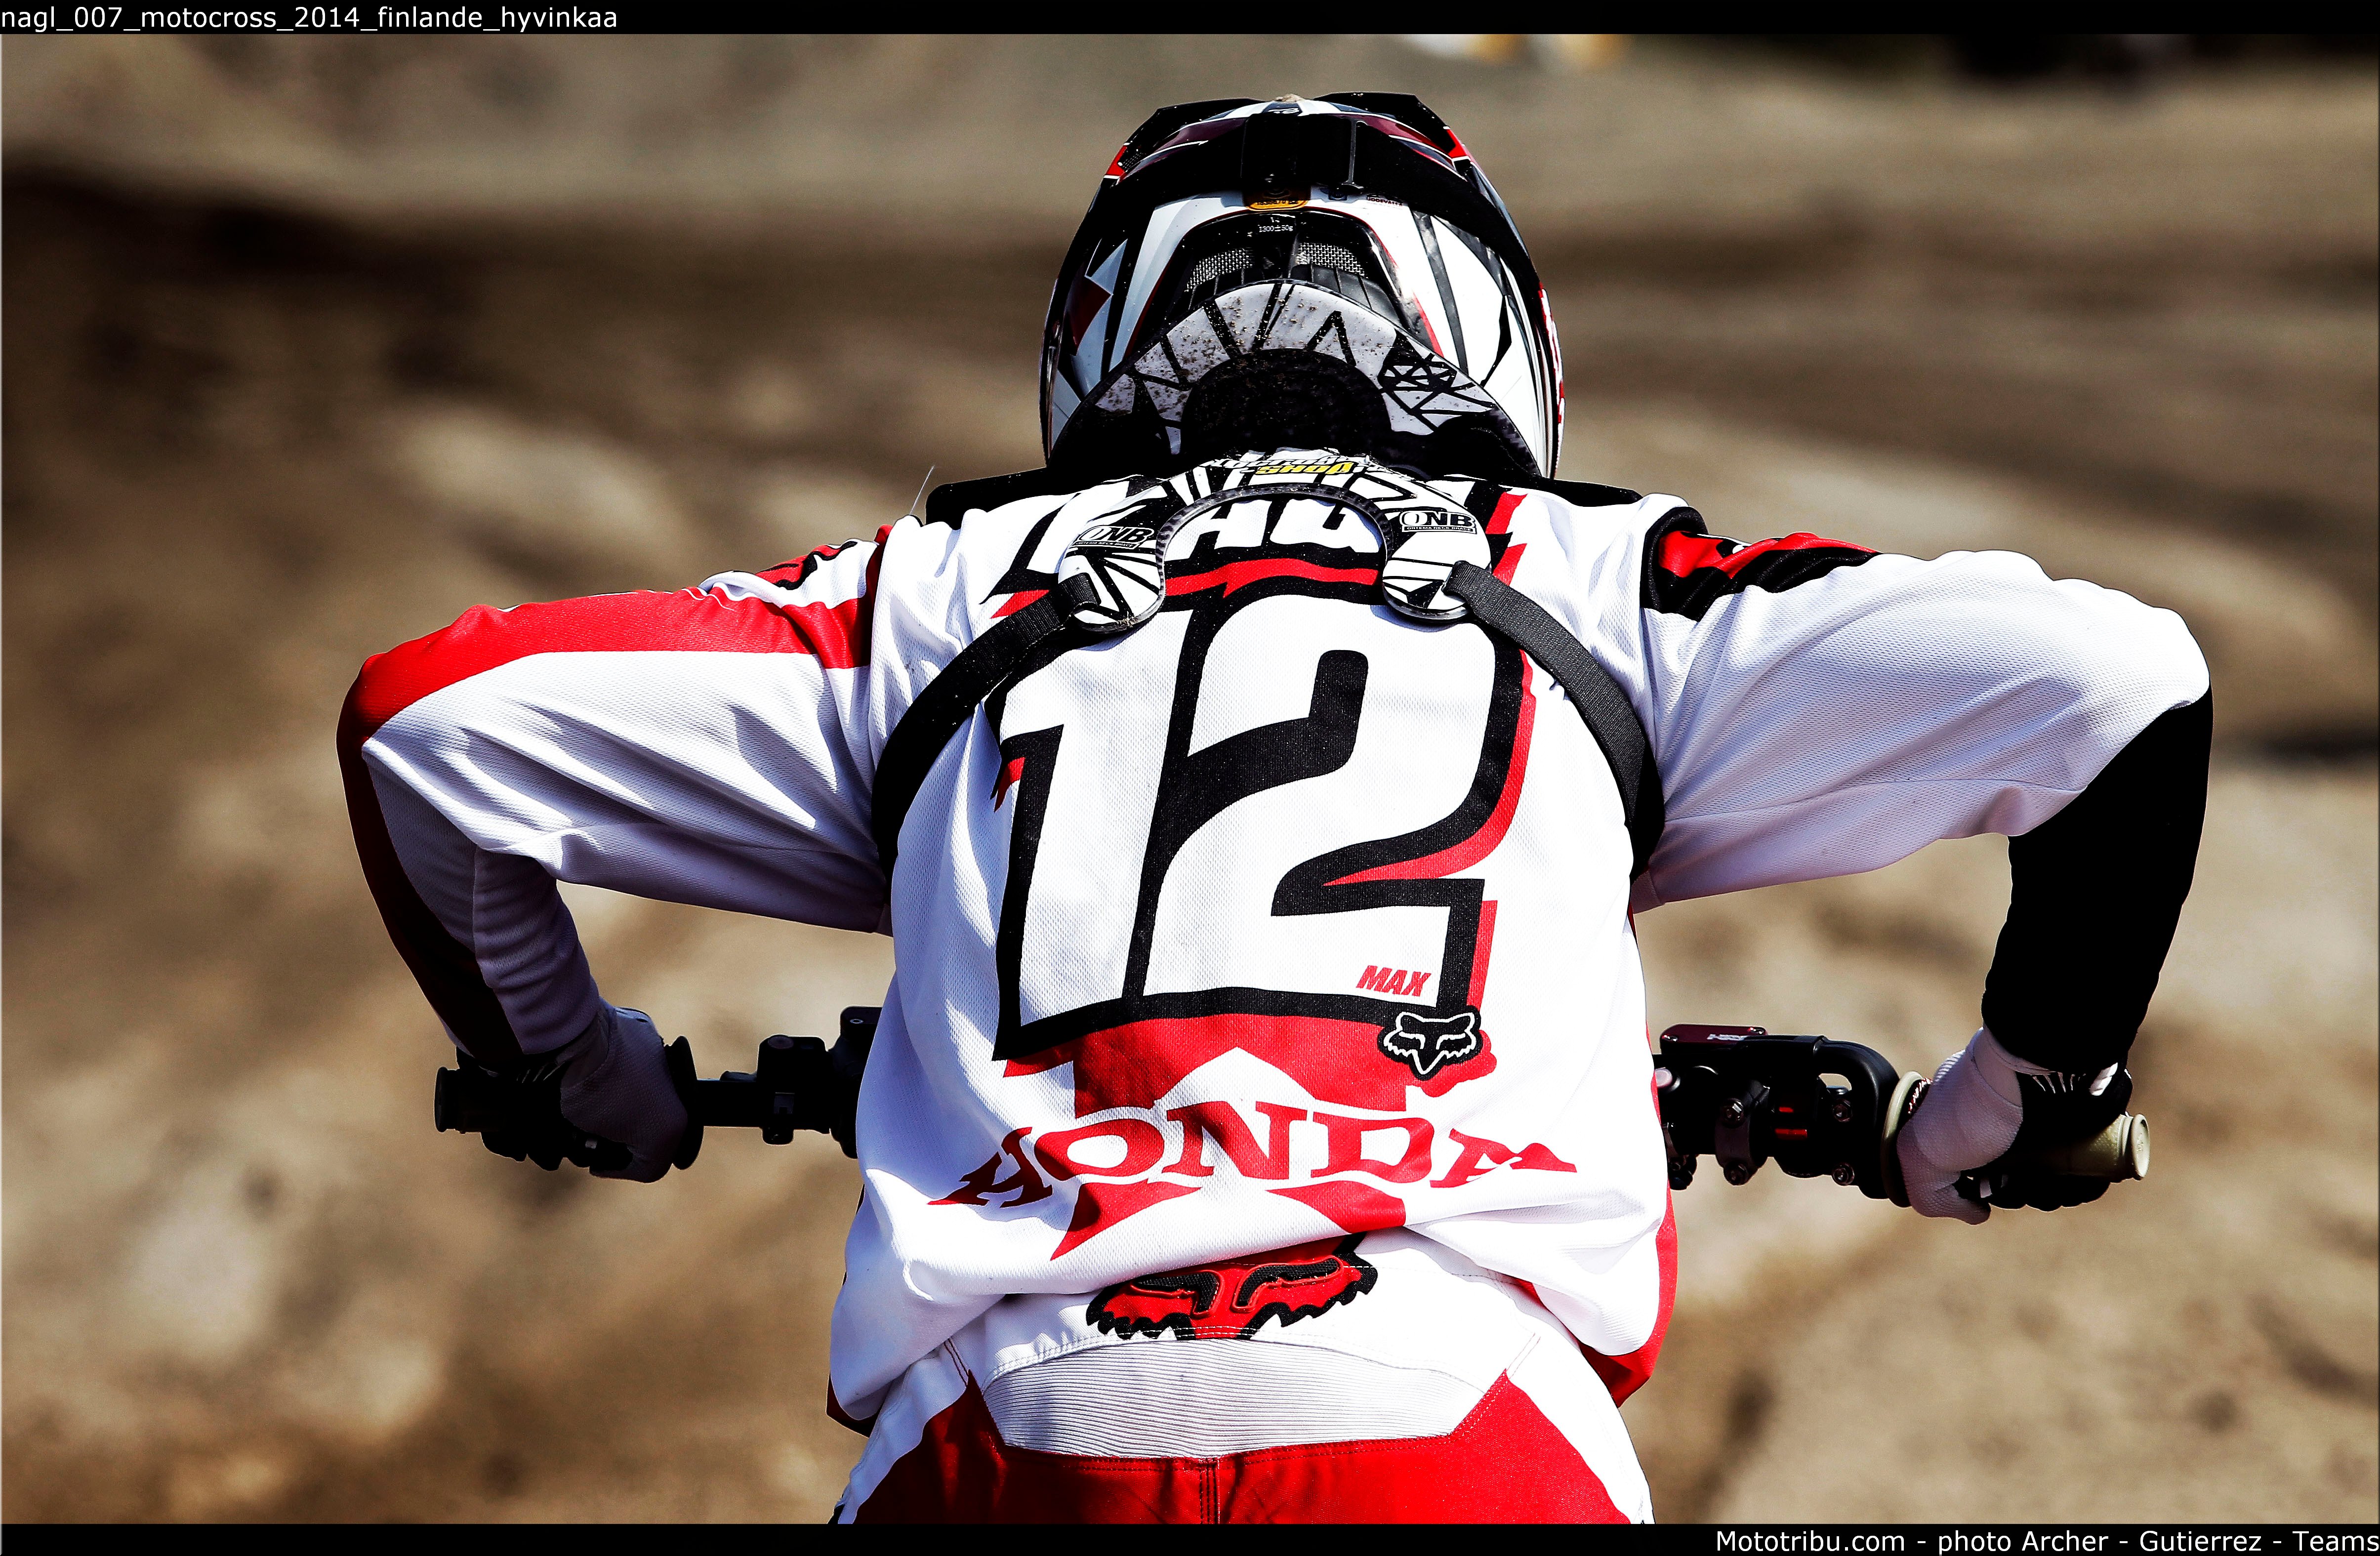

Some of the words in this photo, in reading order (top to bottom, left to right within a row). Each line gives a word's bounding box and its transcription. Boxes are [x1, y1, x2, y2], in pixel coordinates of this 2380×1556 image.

[1078, 525, 1152, 542] ONB
[1401, 512, 1473, 527] ONB
[994, 585, 1507, 1037] 12
[1356, 965, 1431, 997] MAX
[928, 1100, 1577, 1208] HONDA
